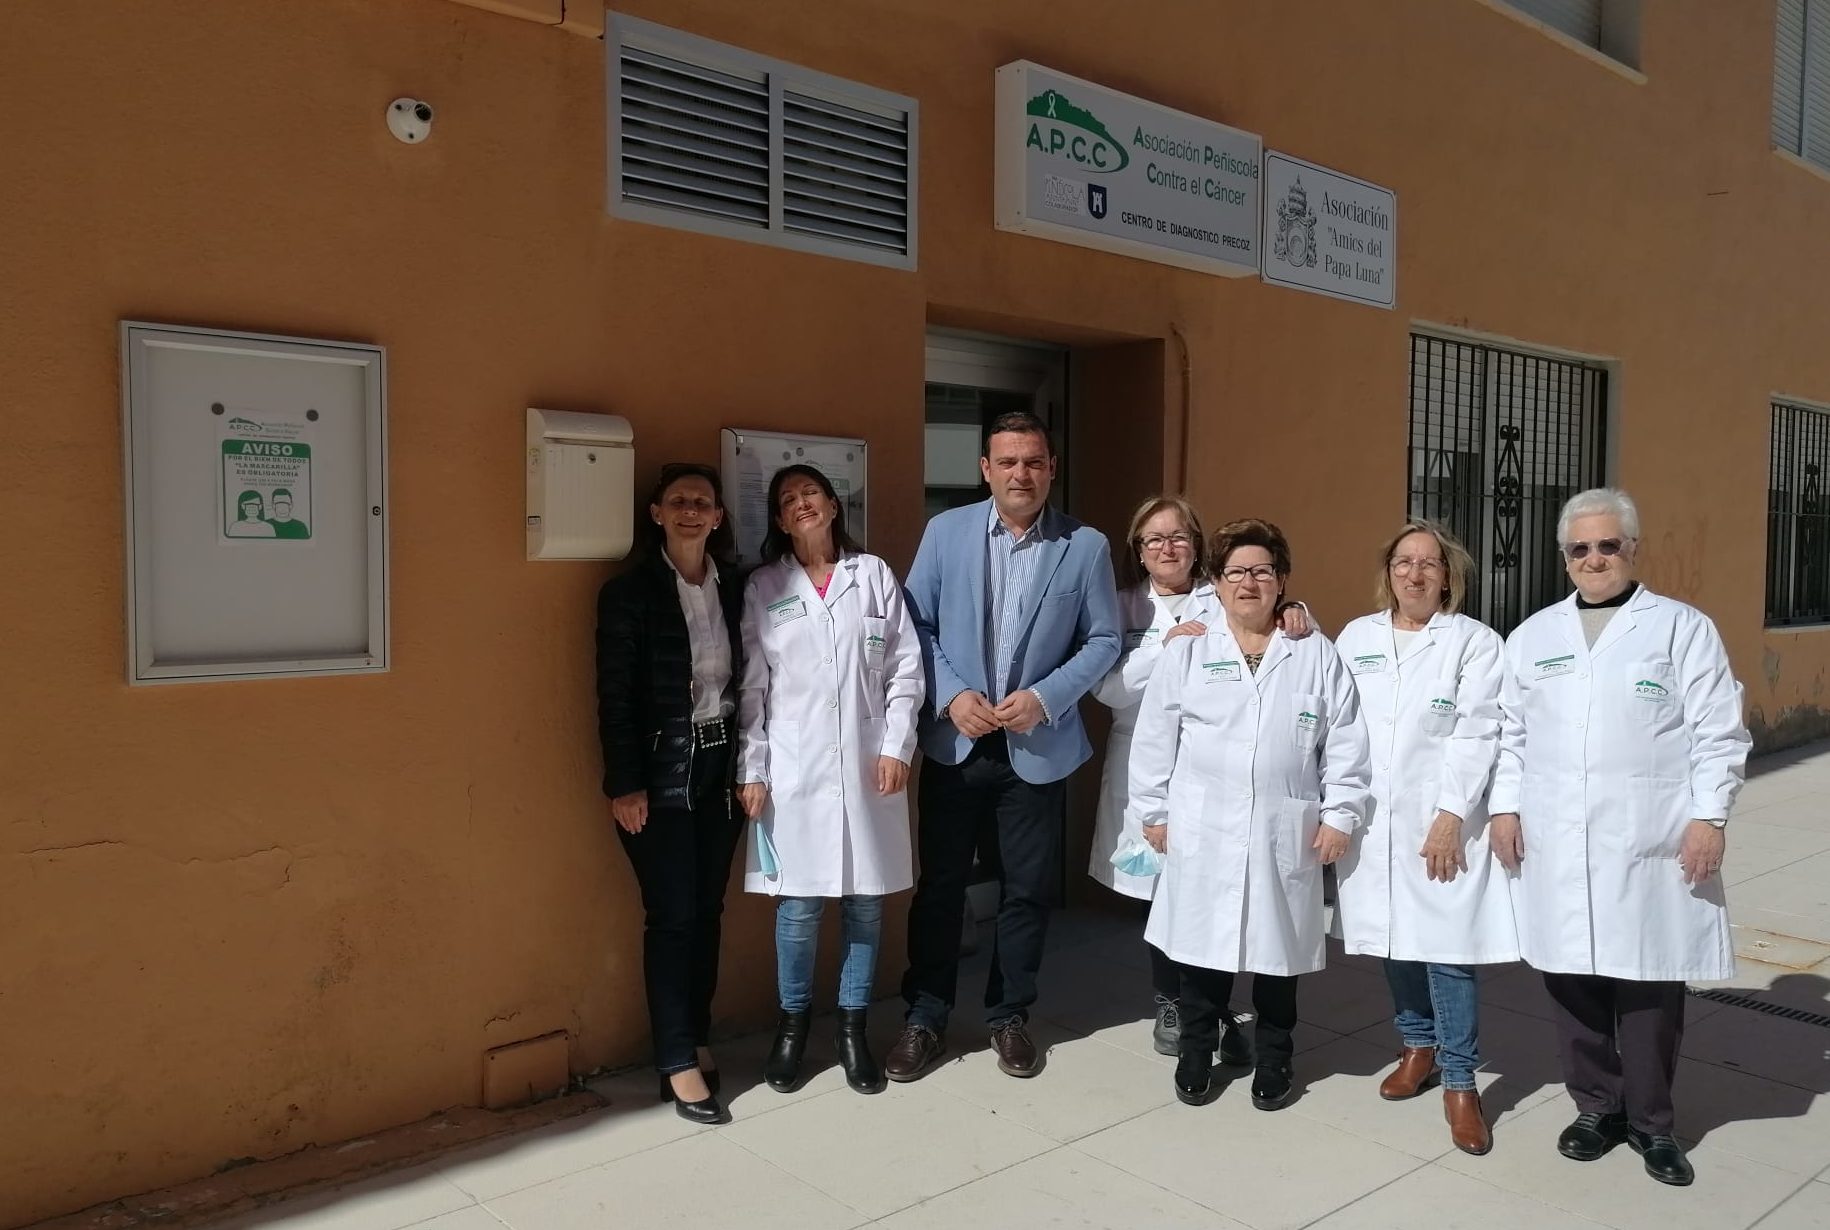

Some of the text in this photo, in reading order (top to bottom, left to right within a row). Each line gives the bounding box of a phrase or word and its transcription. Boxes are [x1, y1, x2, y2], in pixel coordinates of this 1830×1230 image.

[1026, 122, 1107, 168] A.P.C.C
[1133, 125, 1259, 180] Asociación Peñiscola
[1146, 162, 1246, 206] Contra el Cáncer
[1121, 211, 1251, 251] CENTRO DE DIAGNOSTICO PRECOZ
[1320, 191, 1389, 231] Asociación
[1325, 254, 1351, 280] Papa
[1367, 237, 1382, 258] del
[242, 443, 293, 456] AVISO
